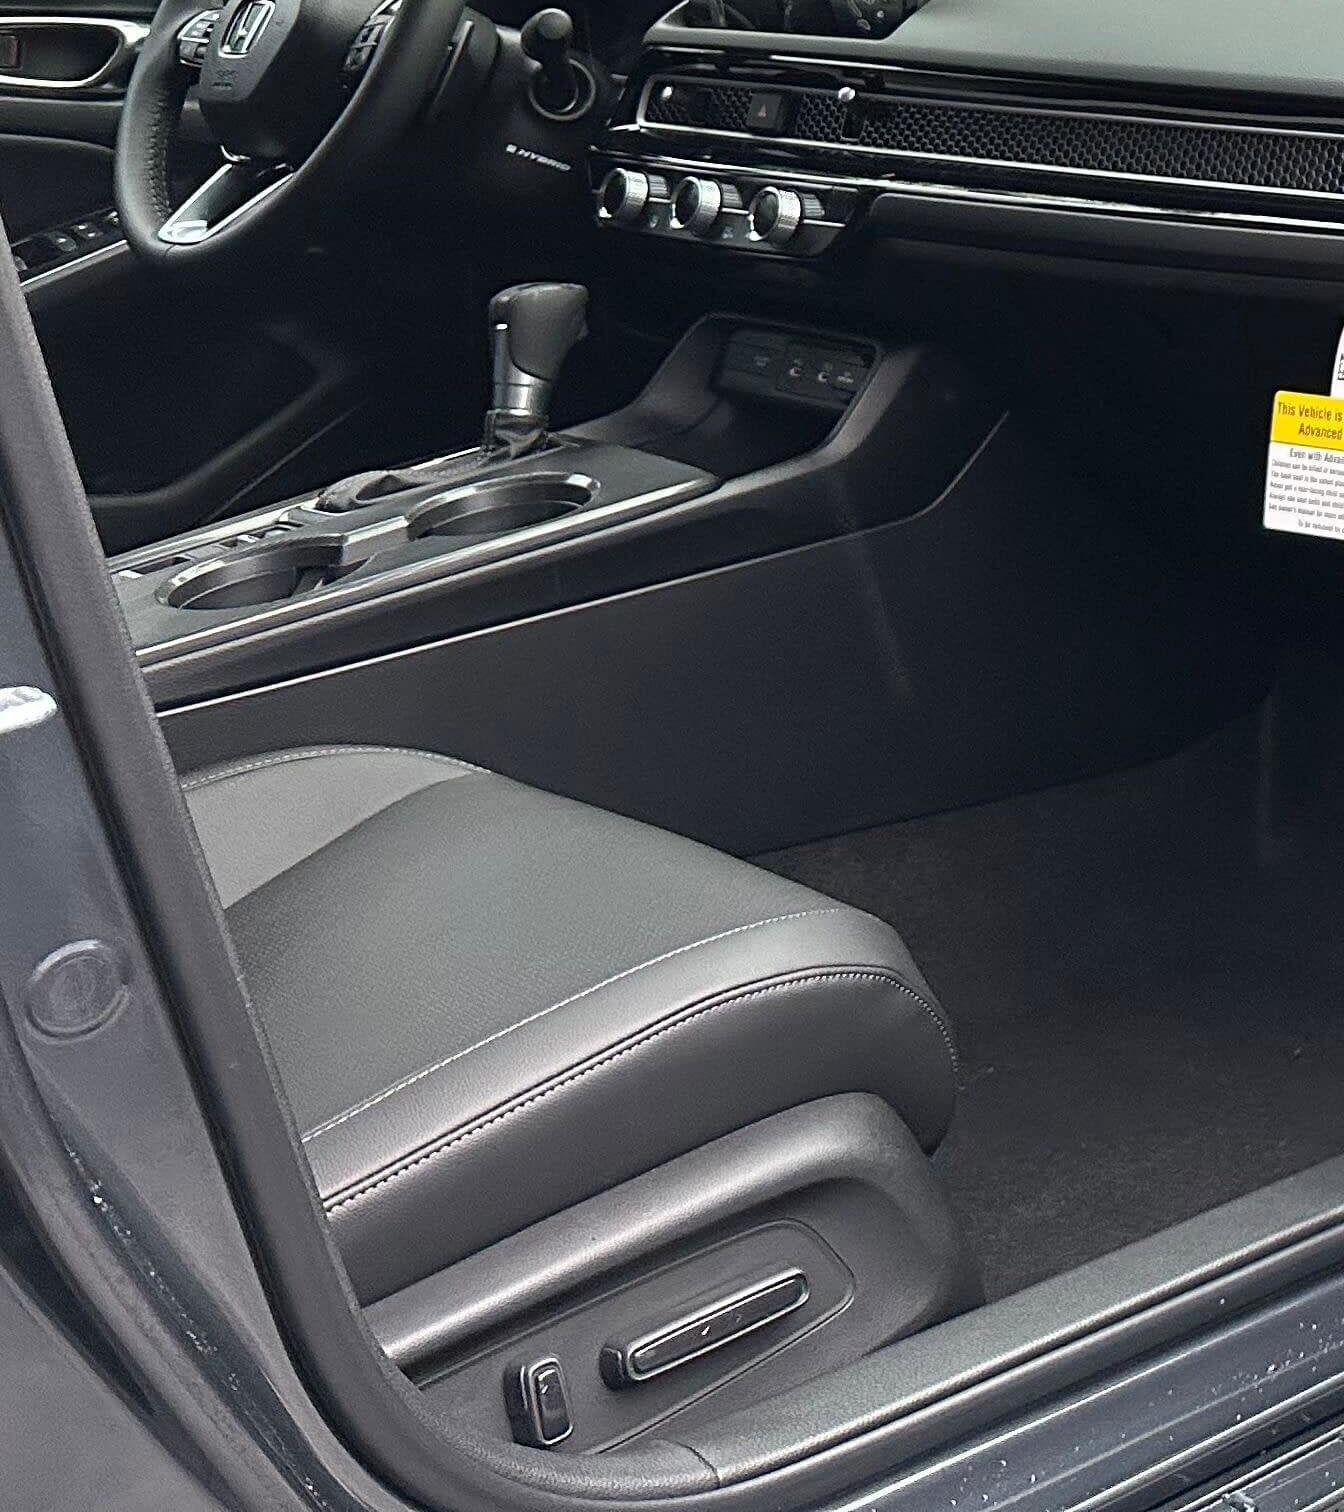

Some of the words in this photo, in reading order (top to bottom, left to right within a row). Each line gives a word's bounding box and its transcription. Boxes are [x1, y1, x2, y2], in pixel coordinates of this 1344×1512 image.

[1278, 401, 1296, 417] This
[1299, 404, 1332, 421] Vehicle
[1335, 411, 1343, 422] is
[1298, 422, 1343, 441] Advanced
